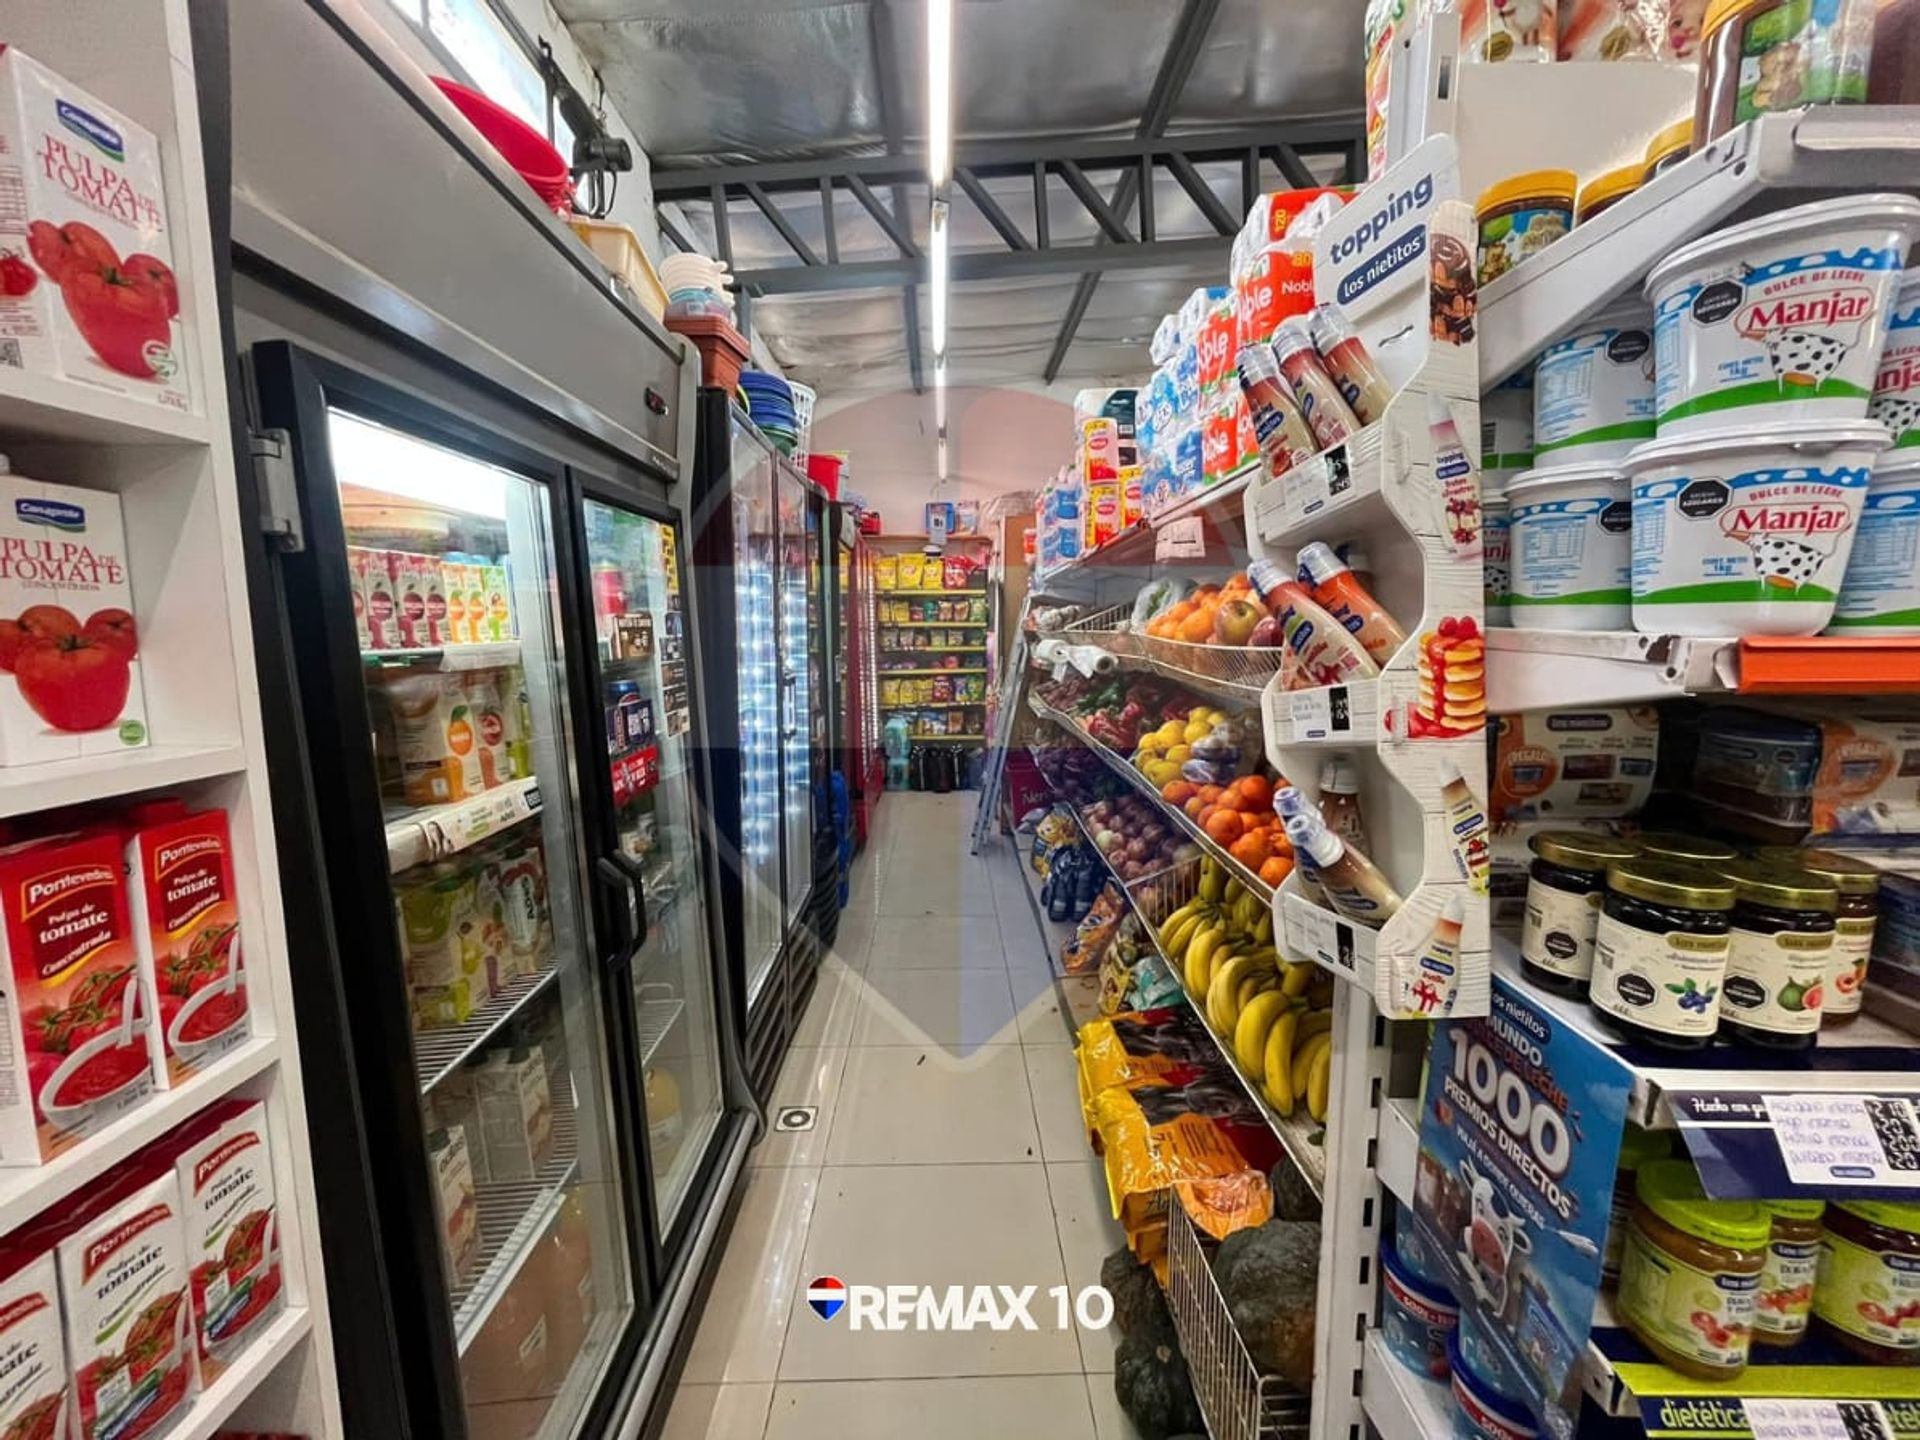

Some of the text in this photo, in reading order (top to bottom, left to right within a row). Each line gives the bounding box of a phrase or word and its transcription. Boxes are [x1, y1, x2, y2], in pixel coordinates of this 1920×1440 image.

[43, 132, 138, 205] PULPA
[36, 151, 163, 232] TOMATE
[1331, 172, 1434, 264] topping
[1344, 236, 1421, 298] los nietitos
[1764, 276, 1805, 296] DULCE
[1749, 292, 1870, 328] Manjar
[1749, 487, 1788, 501] DULCE
[1732, 505, 1846, 536] Manjar
[0, 536, 98, 565] PULPA
[0, 557, 124, 585] TOMATE
[167, 876, 217, 902] tomate
[39, 911, 109, 944] tomate
[42, 930, 112, 975] Concentrada
[1485, 1015, 1543, 1067] MUNDO
[1505, 1003, 1545, 1038] nietitos
[1448, 1027, 1570, 1174] 1000
[1443, 1074, 1572, 1219] PREMIOS DIRECTOS
[204, 1169, 254, 1211] tomate
[97, 1245, 163, 1300] tomate
